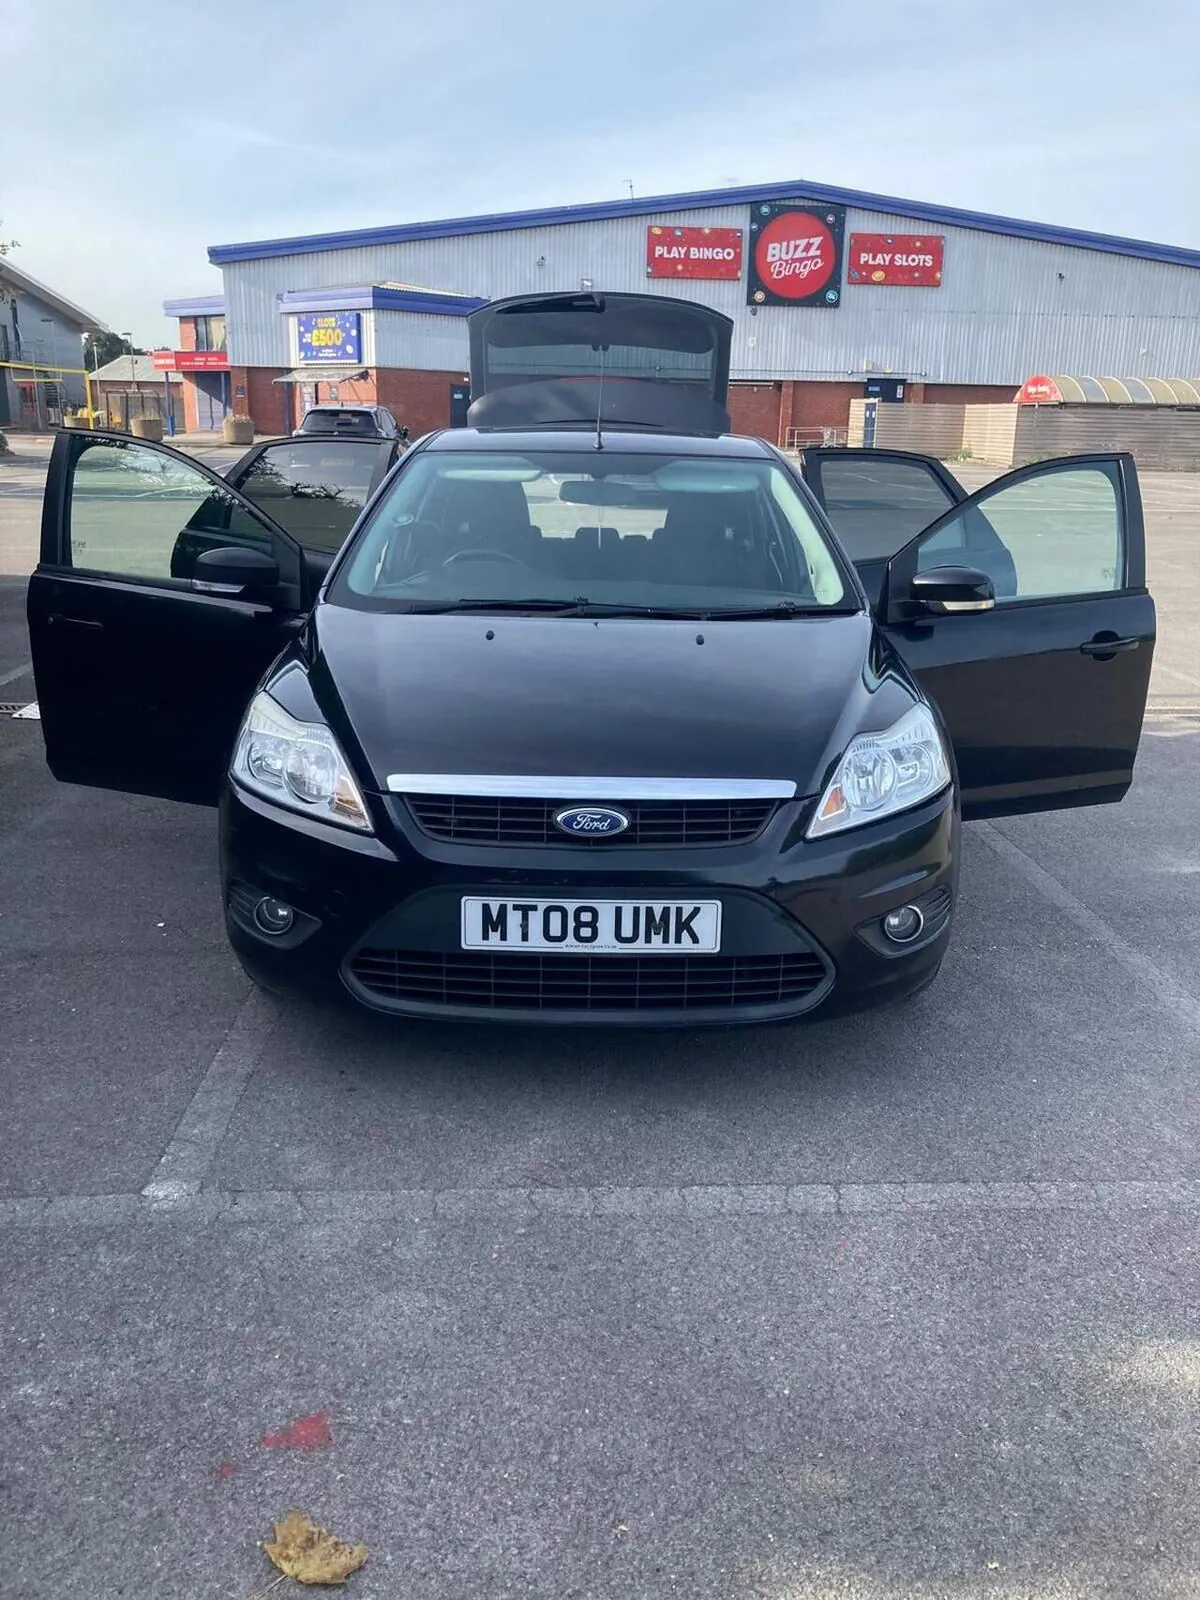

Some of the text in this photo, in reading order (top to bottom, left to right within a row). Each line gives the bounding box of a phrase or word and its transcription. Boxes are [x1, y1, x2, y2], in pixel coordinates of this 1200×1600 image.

[655, 246, 734, 260] PLAY BINGO
[767, 236, 824, 262] BUZZ
[771, 258, 824, 279] Bingo
[860, 253, 933, 267] PLAY SLOTS
[311, 328, 343, 346] £500
[573, 813, 611, 830] Ford
[481, 903, 701, 944] MT08 UMK
